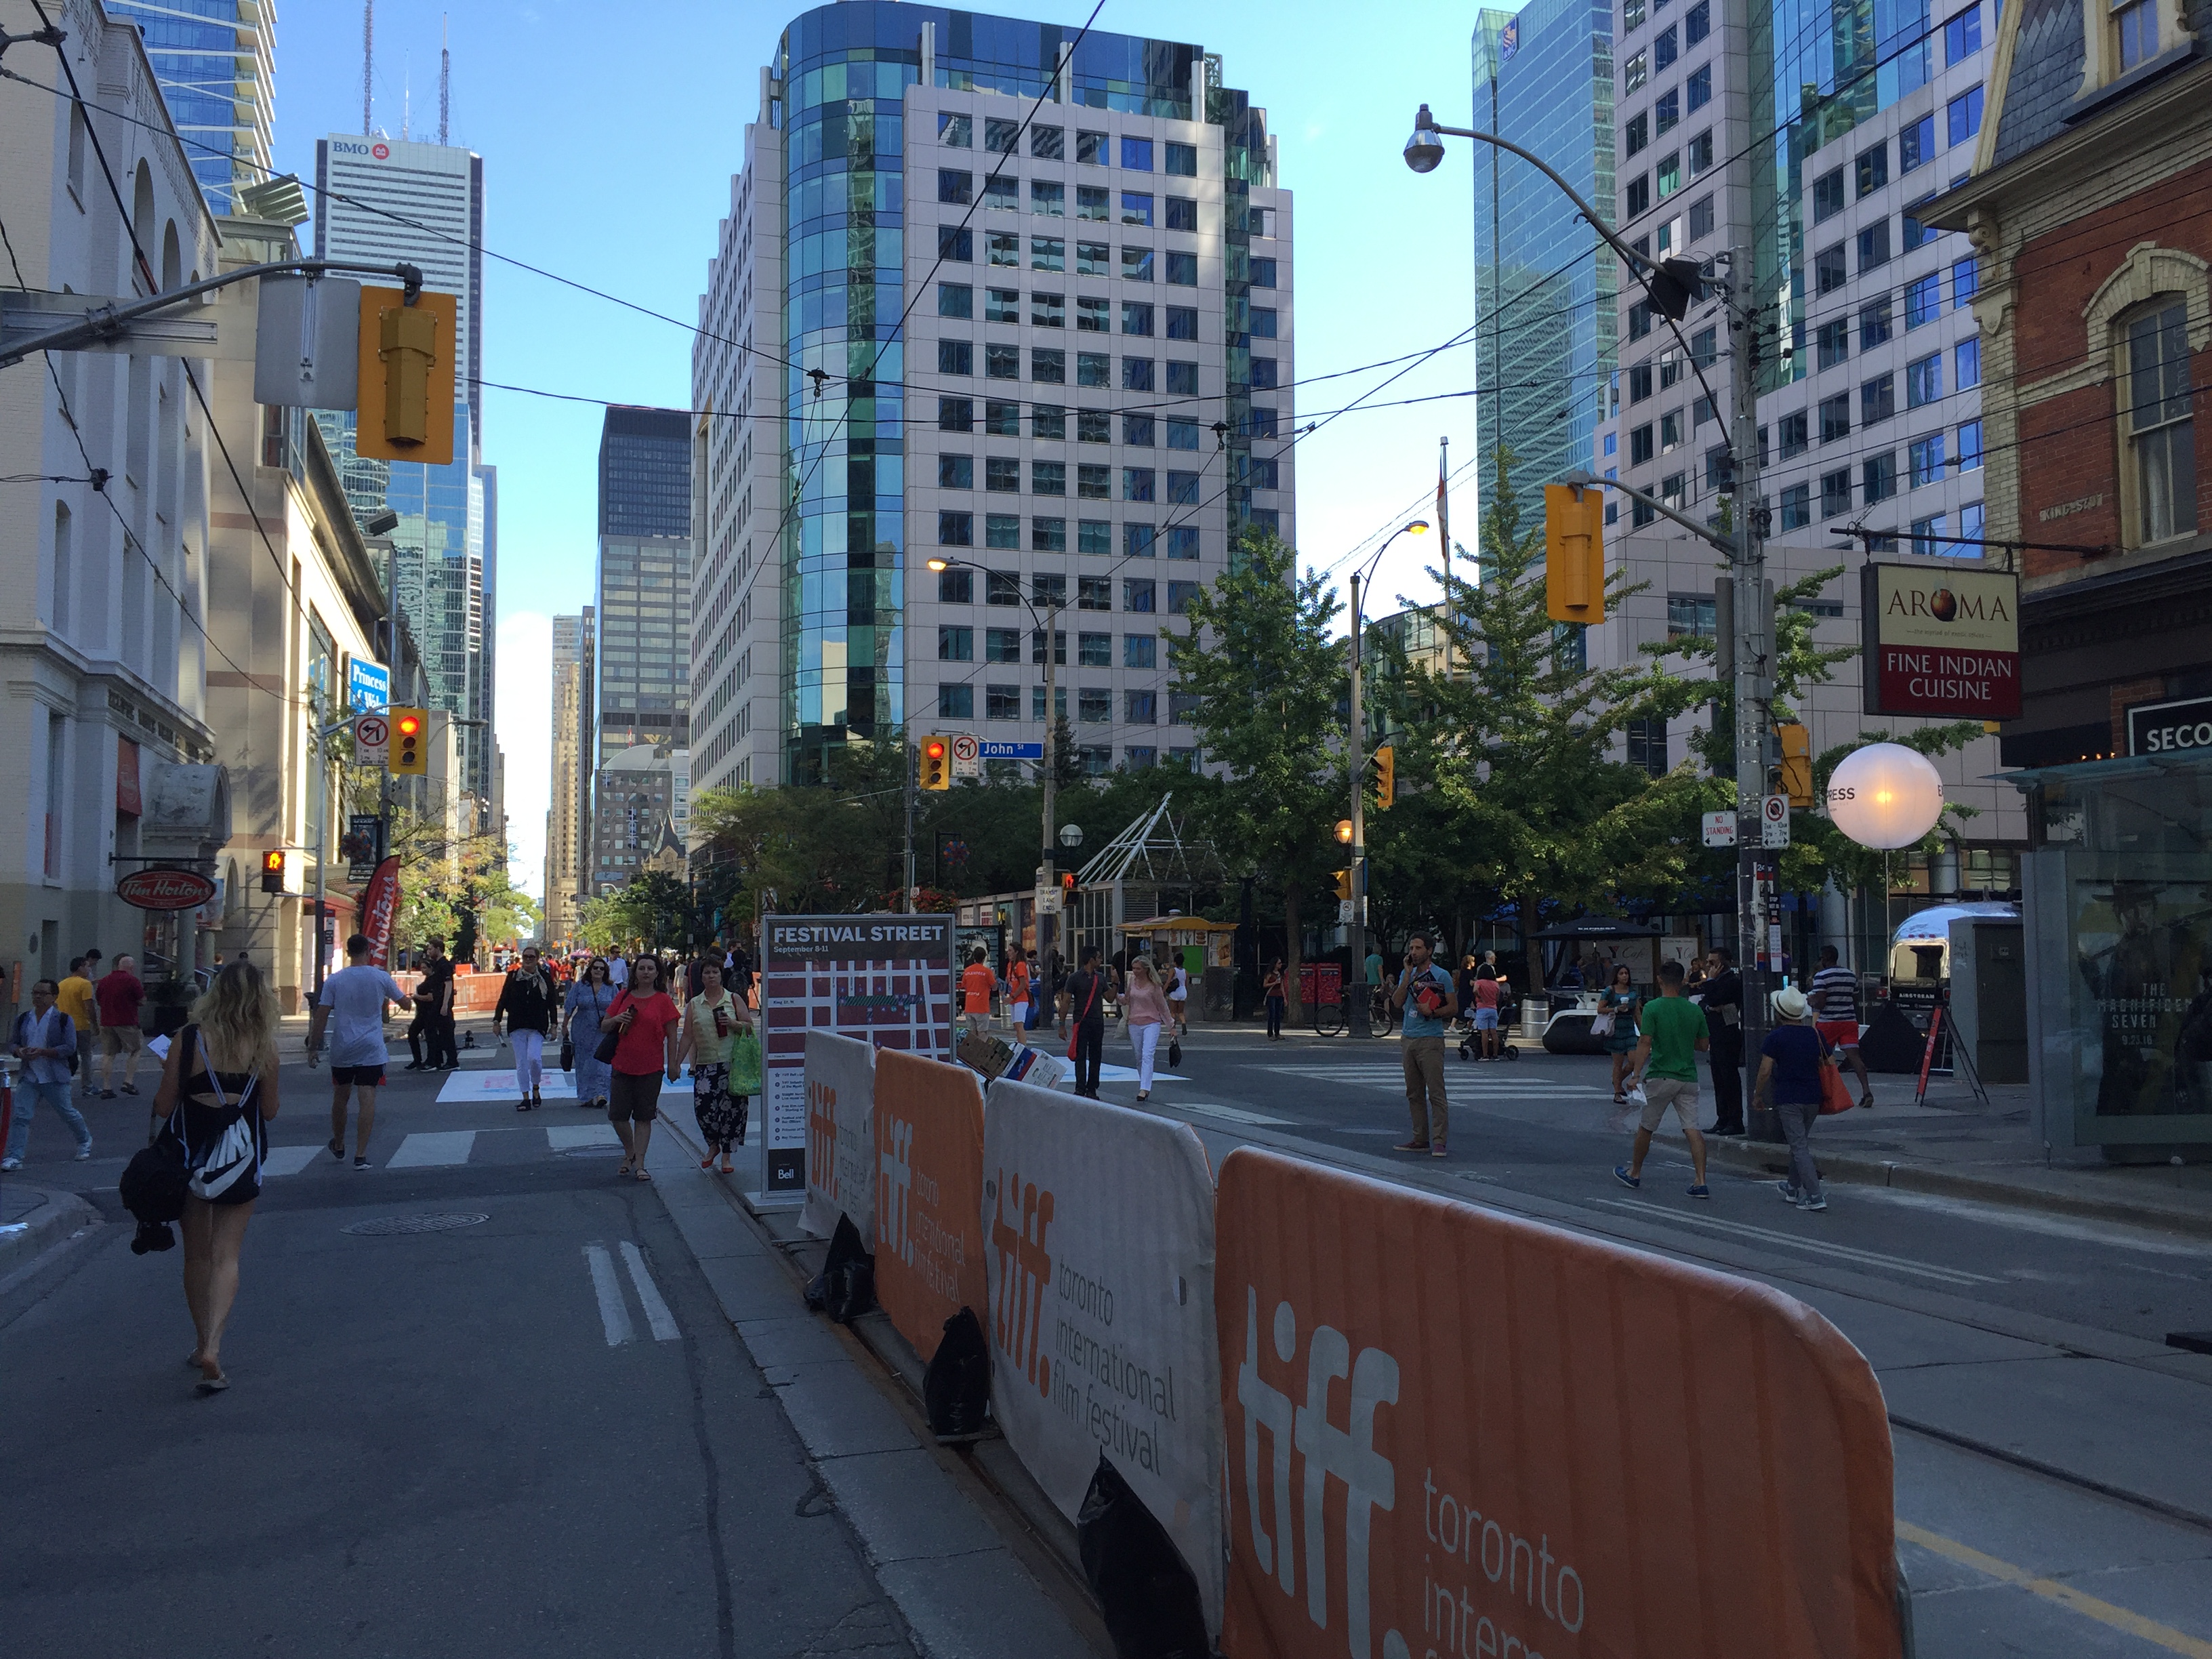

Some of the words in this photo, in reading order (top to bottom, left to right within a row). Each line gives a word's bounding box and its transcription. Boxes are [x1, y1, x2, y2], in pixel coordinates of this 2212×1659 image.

[333, 141, 369, 155] BMO
[1887, 588, 2010, 622] AROMA
[1887, 653, 1932, 674] FINE
[1940, 655, 2011, 678] INDIAN
[352, 664, 386, 692] Princess
[1909, 678, 1992, 700] CUISINE
[984, 743, 1013, 755] John
[1715, 815, 1723, 824] NO
[1706, 826, 1734, 836] STANDING
[123, 880, 150, 895] Tim
[152, 880, 211, 896] Hortons
[371, 872, 396, 960] Hortons
[774, 926, 865, 943] FESTIVAL
[870, 926, 944, 941] STREET
[773, 945, 813, 954] September
[2142, 983, 2167, 997] THE
[2097, 998, 2193, 1012] MAGNIFICEN
[2111, 1014, 2156, 1029] SEVEN
[778, 1168, 794, 1179] Bell
[1059, 1254, 1113, 1327] toronto
[1055, 1304, 1176, 1422] international
[1053, 1357, 1079, 1425] film
[1086, 1383, 1161, 1477] festival
[1424, 1466, 1584, 1634] toronto
